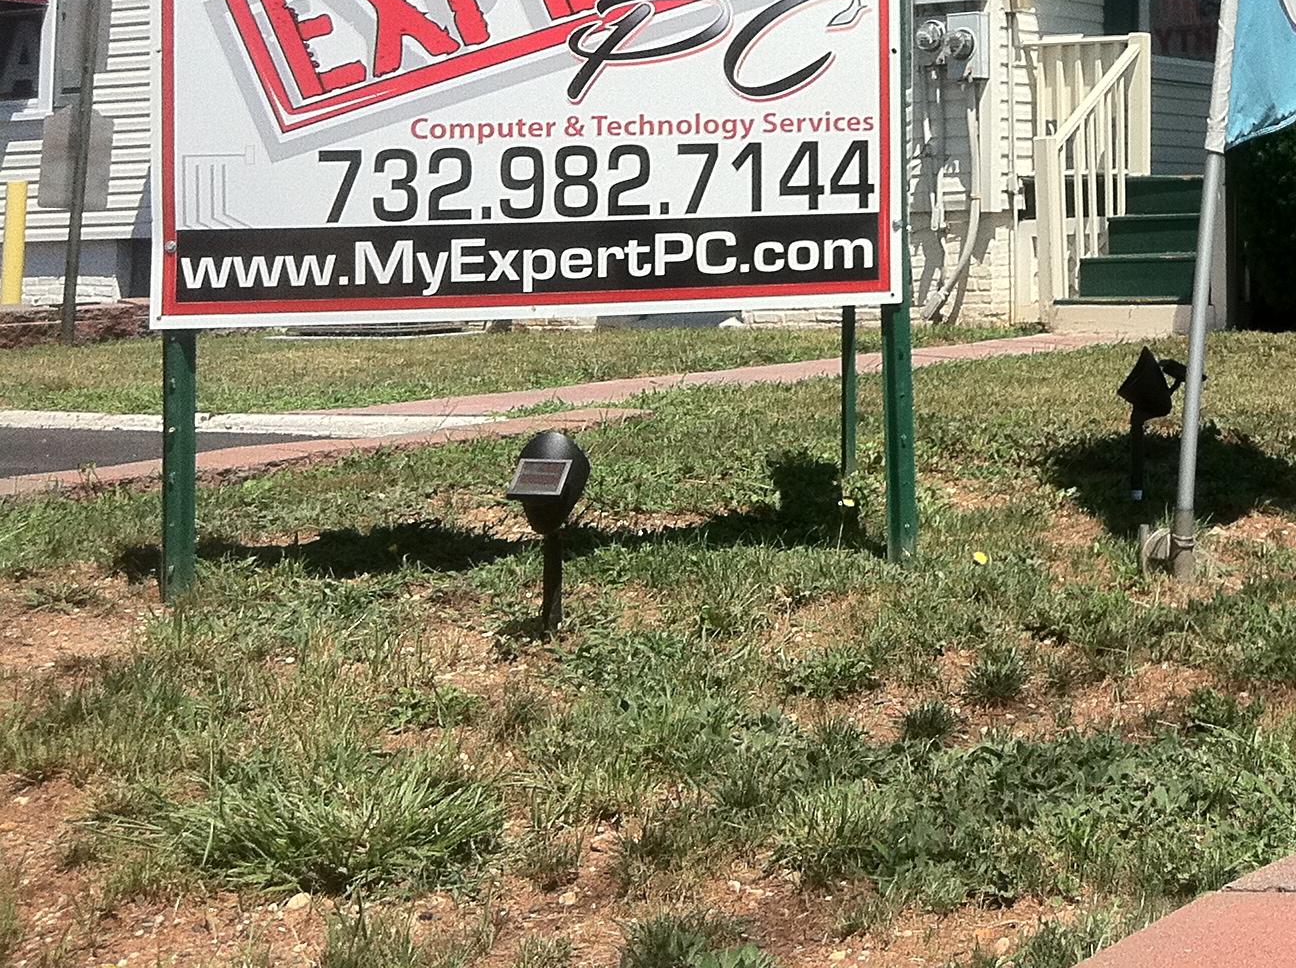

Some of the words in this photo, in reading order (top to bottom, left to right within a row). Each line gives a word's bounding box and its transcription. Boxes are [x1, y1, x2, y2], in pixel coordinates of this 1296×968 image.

[410, 116, 556, 143] Computer
[564, 114, 586, 138] &
[591, 113, 754, 142] Technology
[762, 110, 875, 134] Services
[316, 139, 876, 224] 732.982.7144
[180, 230, 875, 295] www.MyExpertPC.com
